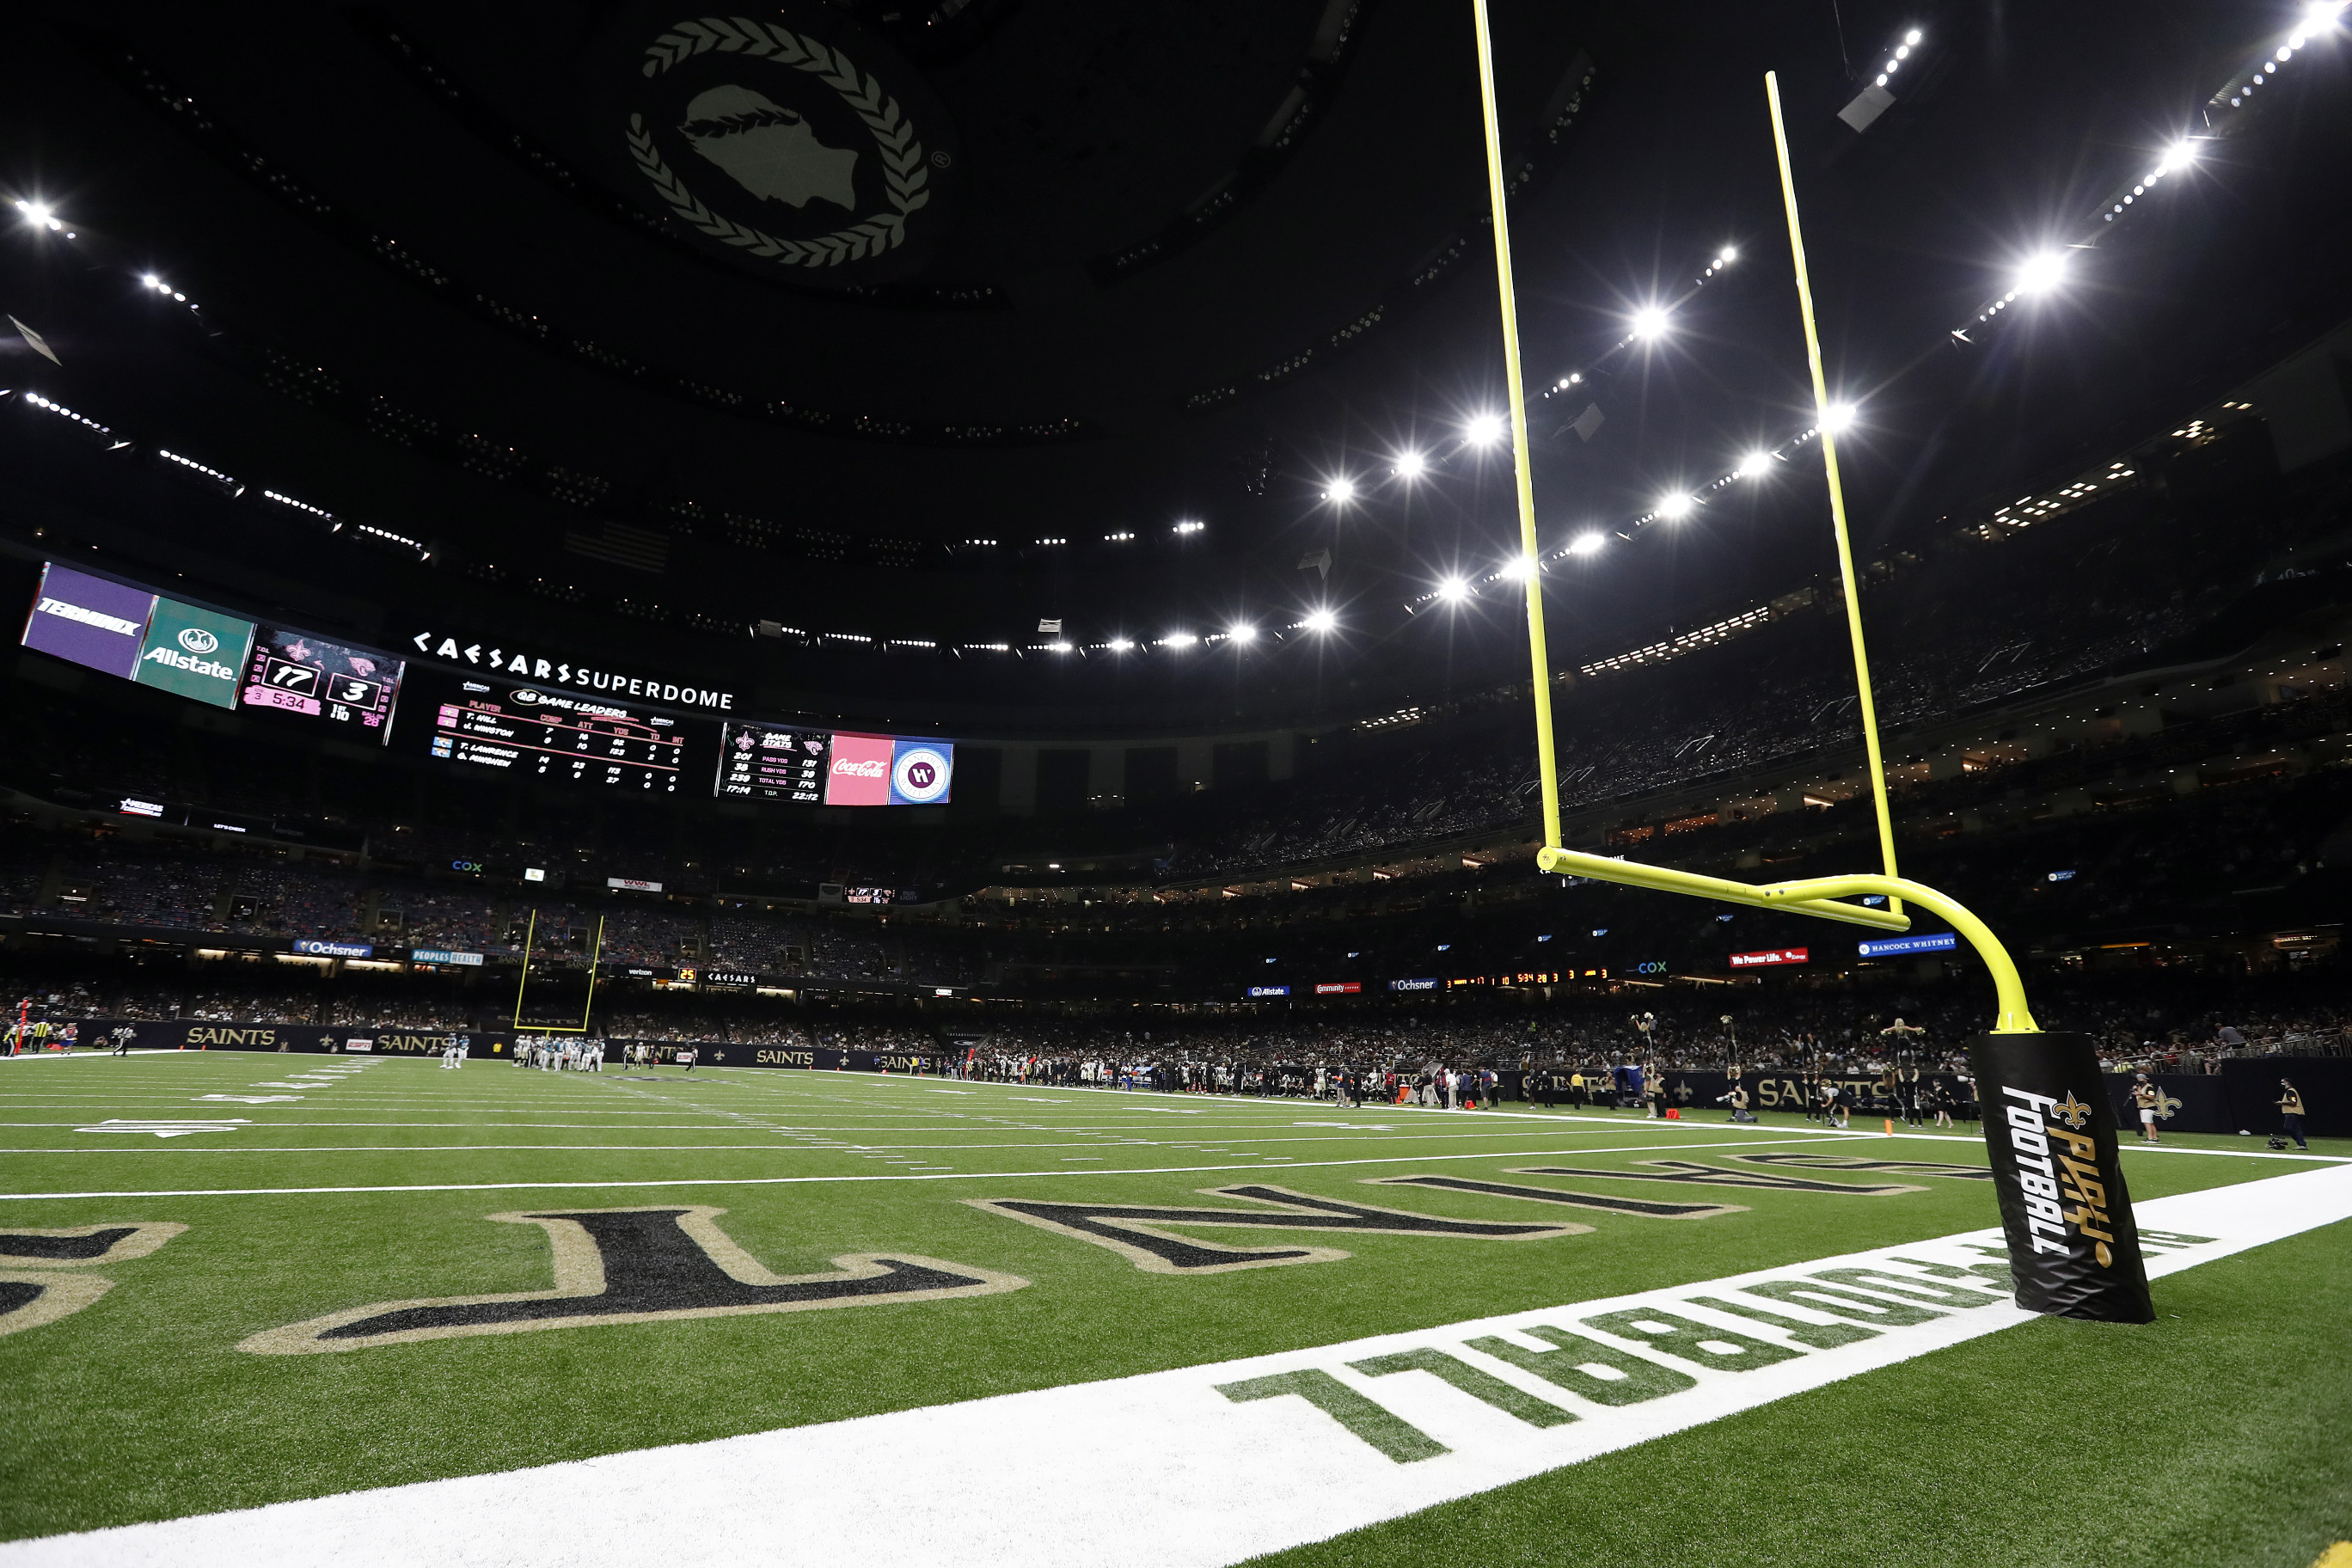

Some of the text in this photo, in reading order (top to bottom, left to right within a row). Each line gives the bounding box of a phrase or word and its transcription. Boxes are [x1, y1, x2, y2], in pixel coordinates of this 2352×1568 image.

[37, 597, 141, 636] TERMINIX
[273, 665, 313, 687] 17
[413, 632, 733, 710] CAESARS SUPERDOME
[342, 682, 368, 701] 3
[273, 693, 305, 710] 5:34
[517, 691, 627, 718] QB GAME LEADERS
[363, 716, 379, 727] 28
[466, 712, 475, 720] T.
[476, 714, 497, 724] HILL
[469, 700, 501, 713] PLAYER
[540, 714, 562, 723] COMP
[578, 721, 593, 730] ATT
[614, 726, 628, 736] YDS
[672, 736, 684, 744] INT
[474, 724, 514, 738] WINSTON
[764, 732, 792, 742] GAME
[763, 739, 792, 749] STATS
[469, 754, 511, 768] MINSHEW
[470, 744, 519, 758] LAWRENCE
[538, 756, 550, 764] 14
[733, 752, 752, 761] 201
[734, 763, 749, 772] 38
[832, 758, 887, 778] Coca-Cola
[730, 774, 750, 782] 239
[798, 781, 816, 789] 170
[726, 785, 751, 795] 17:14
[792, 792, 818, 801] 22:12
[451, 861, 482, 872] COX
[309, 941, 366, 957] Ochsner
[1872, 938, 1955, 952] HANCOCK WHITNEY
[413, 950, 481, 964] PEOPLES HEALTH
[1732, 956, 1743, 965] We
[1743, 955, 1766, 965] Power
[1766, 953, 1782, 962] Life.
[1638, 961, 1667, 973] COX
[680, 970, 695, 980] 25
[708, 972, 756, 983] CAESARS
[1447, 980, 1451, 989] 3
[1477, 977, 1485, 985] 17
[1503, 977, 1510, 985] 10
[1517, 973, 1534, 983] 5:34
[1537, 974, 1547, 983] 28
[1553, 973, 1559, 983] 3
[1569, 970, 1574, 979] 3
[1602, 969, 1607, 979] 3
[1317, 983, 1344, 994] Community
[1397, 980, 1434, 990] Ochsner
[187, 1027, 275, 1046] SAINTS
[347, 1039, 371, 1050] ESPN
[756, 1050, 814, 1065] SAINTS
[2002, 1086, 2070, 1255] FOOTBALL
[1213, 1255, 2016, 1464] FOOTBALL
